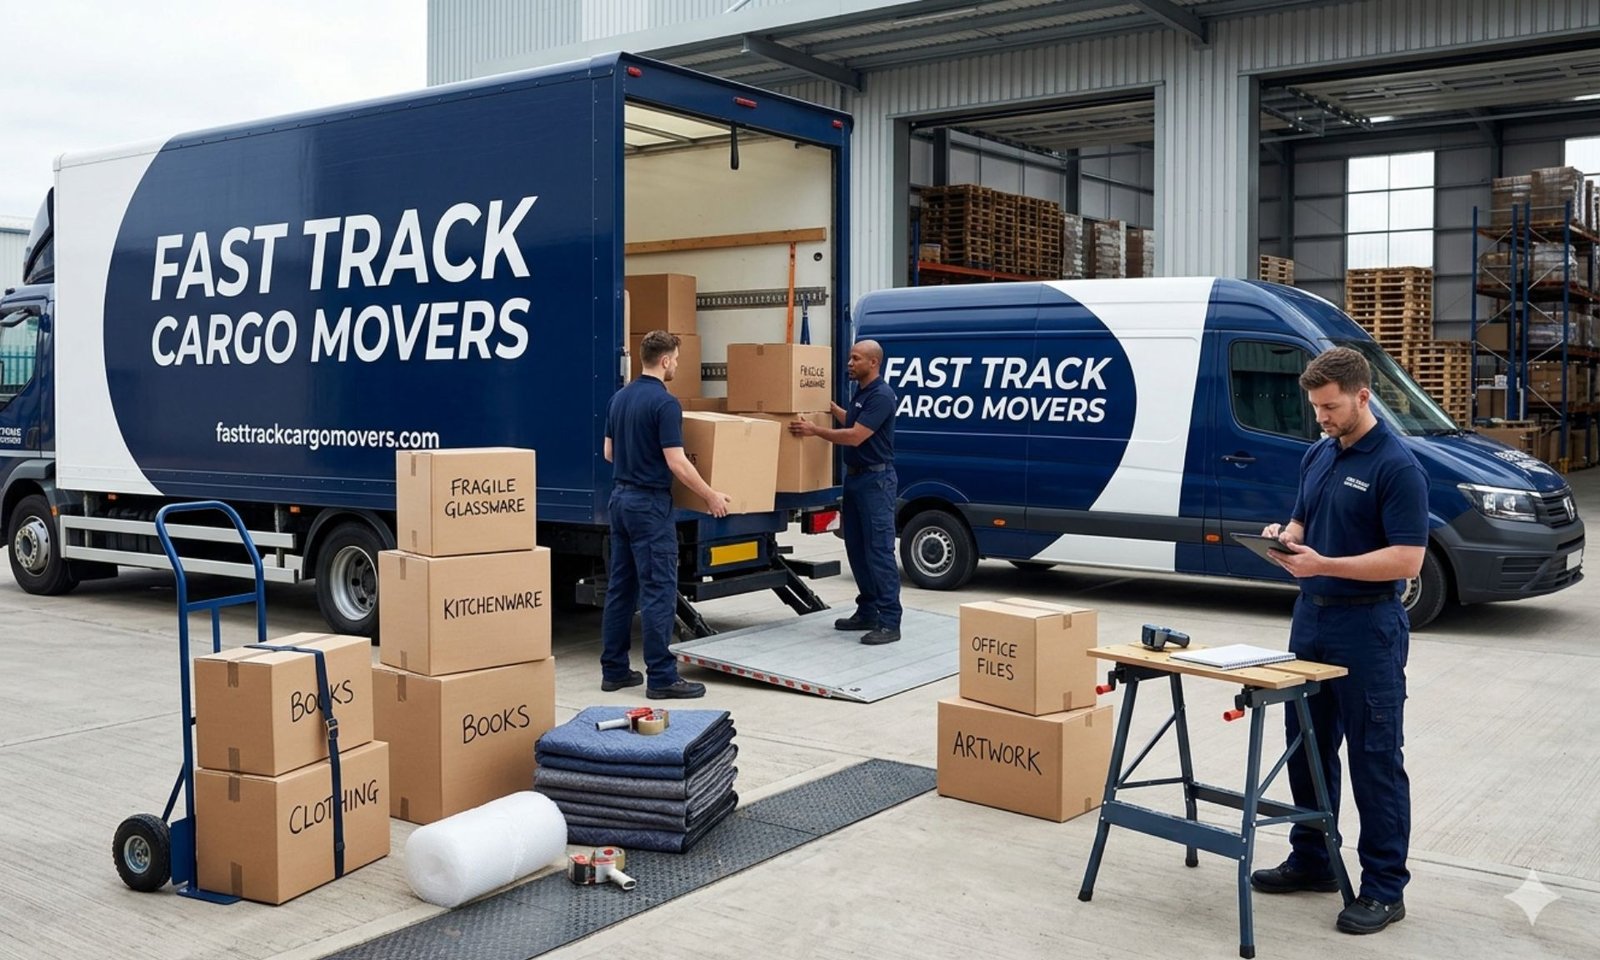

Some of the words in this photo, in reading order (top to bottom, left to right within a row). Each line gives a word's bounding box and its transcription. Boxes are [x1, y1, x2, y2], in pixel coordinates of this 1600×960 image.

[151, 223, 288, 301] FAST
[303, 196, 538, 290] TRACK
[151, 309, 298, 367] CARGO
[310, 297, 530, 364] MOVERS
[883, 357, 972, 388] FAST
[981, 357, 1112, 390] TRACK
[894, 394, 974, 419] ARGO
[981, 396, 1107, 423] MOVERS
[215, 421, 440, 450] fasttrackcargomovers.com
[450, 477, 516, 498] FRAGILE
[443, 591, 543, 620] KITCHENWARE
[971, 636, 1018, 659] OFFICE
[977, 657, 1014, 681] FILES
[463, 704, 530, 745] BOOKS
[952, 730, 1042, 776] ARTWORK
[289, 779, 379, 834] CLOTHING
